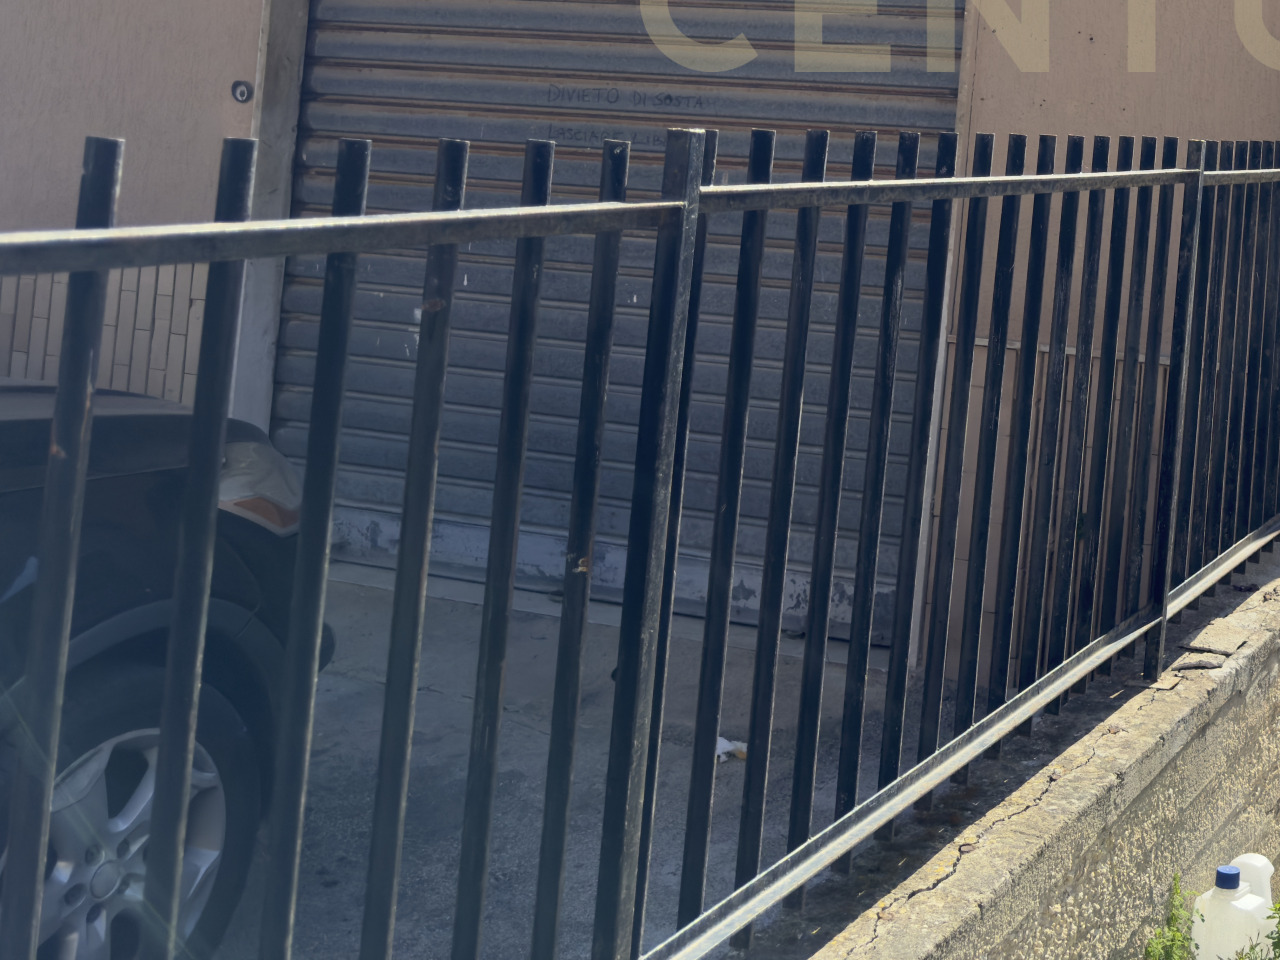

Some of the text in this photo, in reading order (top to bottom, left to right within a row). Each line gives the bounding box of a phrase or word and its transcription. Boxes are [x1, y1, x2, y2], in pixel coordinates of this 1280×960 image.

[547, 83, 703, 109] DIVIETO DI SOSTA
